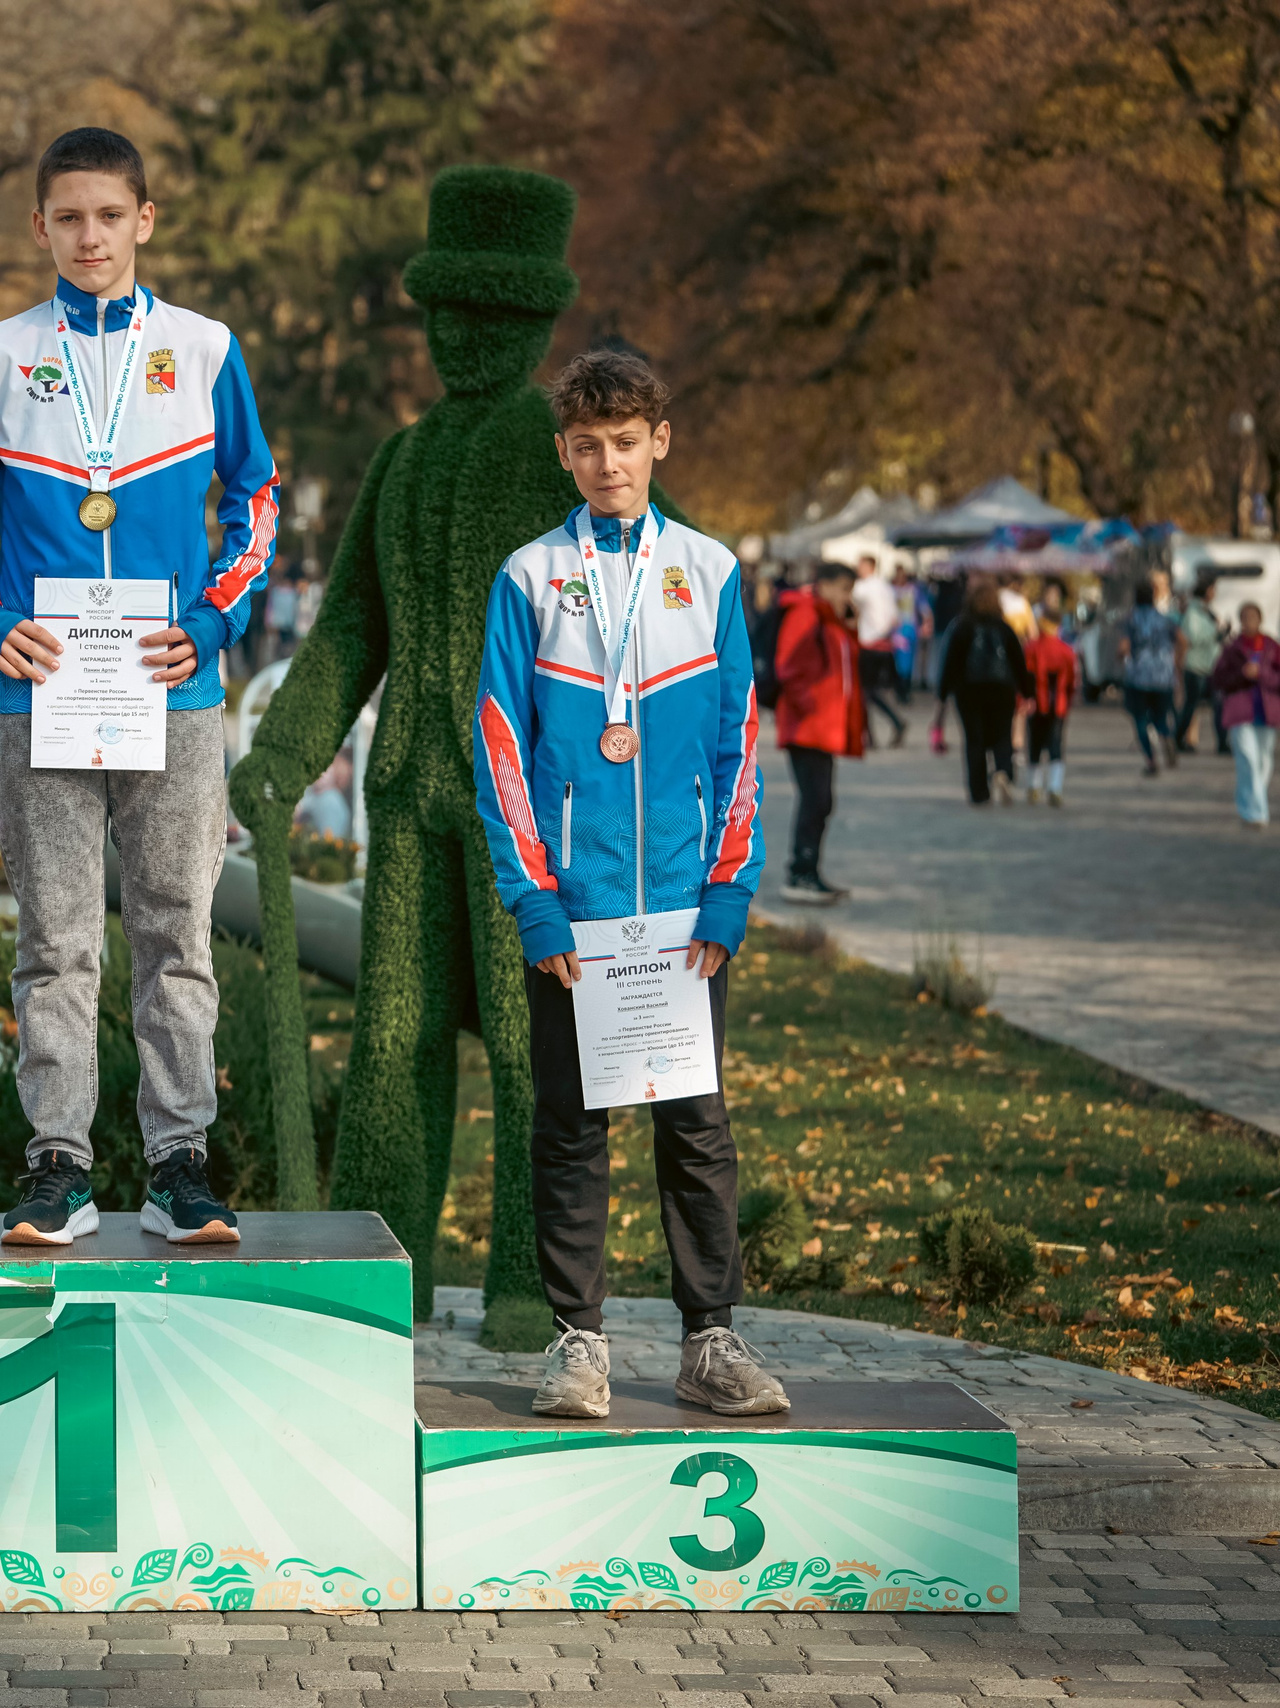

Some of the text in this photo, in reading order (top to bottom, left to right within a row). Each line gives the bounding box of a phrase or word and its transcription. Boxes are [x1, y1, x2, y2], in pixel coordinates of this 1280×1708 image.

[43, 356, 63, 368] ВОРОН
[62, 340, 93, 444] МИНИСТЕРСТВО СПОРТА РОССИИ
[107, 340, 137, 444] МИНИСТЕРСТВО СПОРТА РОССИИ
[590, 568, 600, 595] РОССИИ
[627, 567, 644, 617] МИНИСТЕРСТВО
[557, 599, 571, 614] СШОР
[68, 628, 133, 640] ДИПЛОМ
[623, 618, 631, 643] СПОРТА
[621, 945, 651, 953] МИНСПОРТ
[606, 961, 671, 980] ДИПЛОМ
[616, 978, 663, 989] III степень
[620, 991, 663, 1001] НАГРАЖДАЕТСЯ
[646, 1001, 668, 1009] Василий
[609, 1033, 643, 1041] спортивному
[645, 1027, 689, 1037] ориентированию
[668, 1450, 766, 1571] 3
